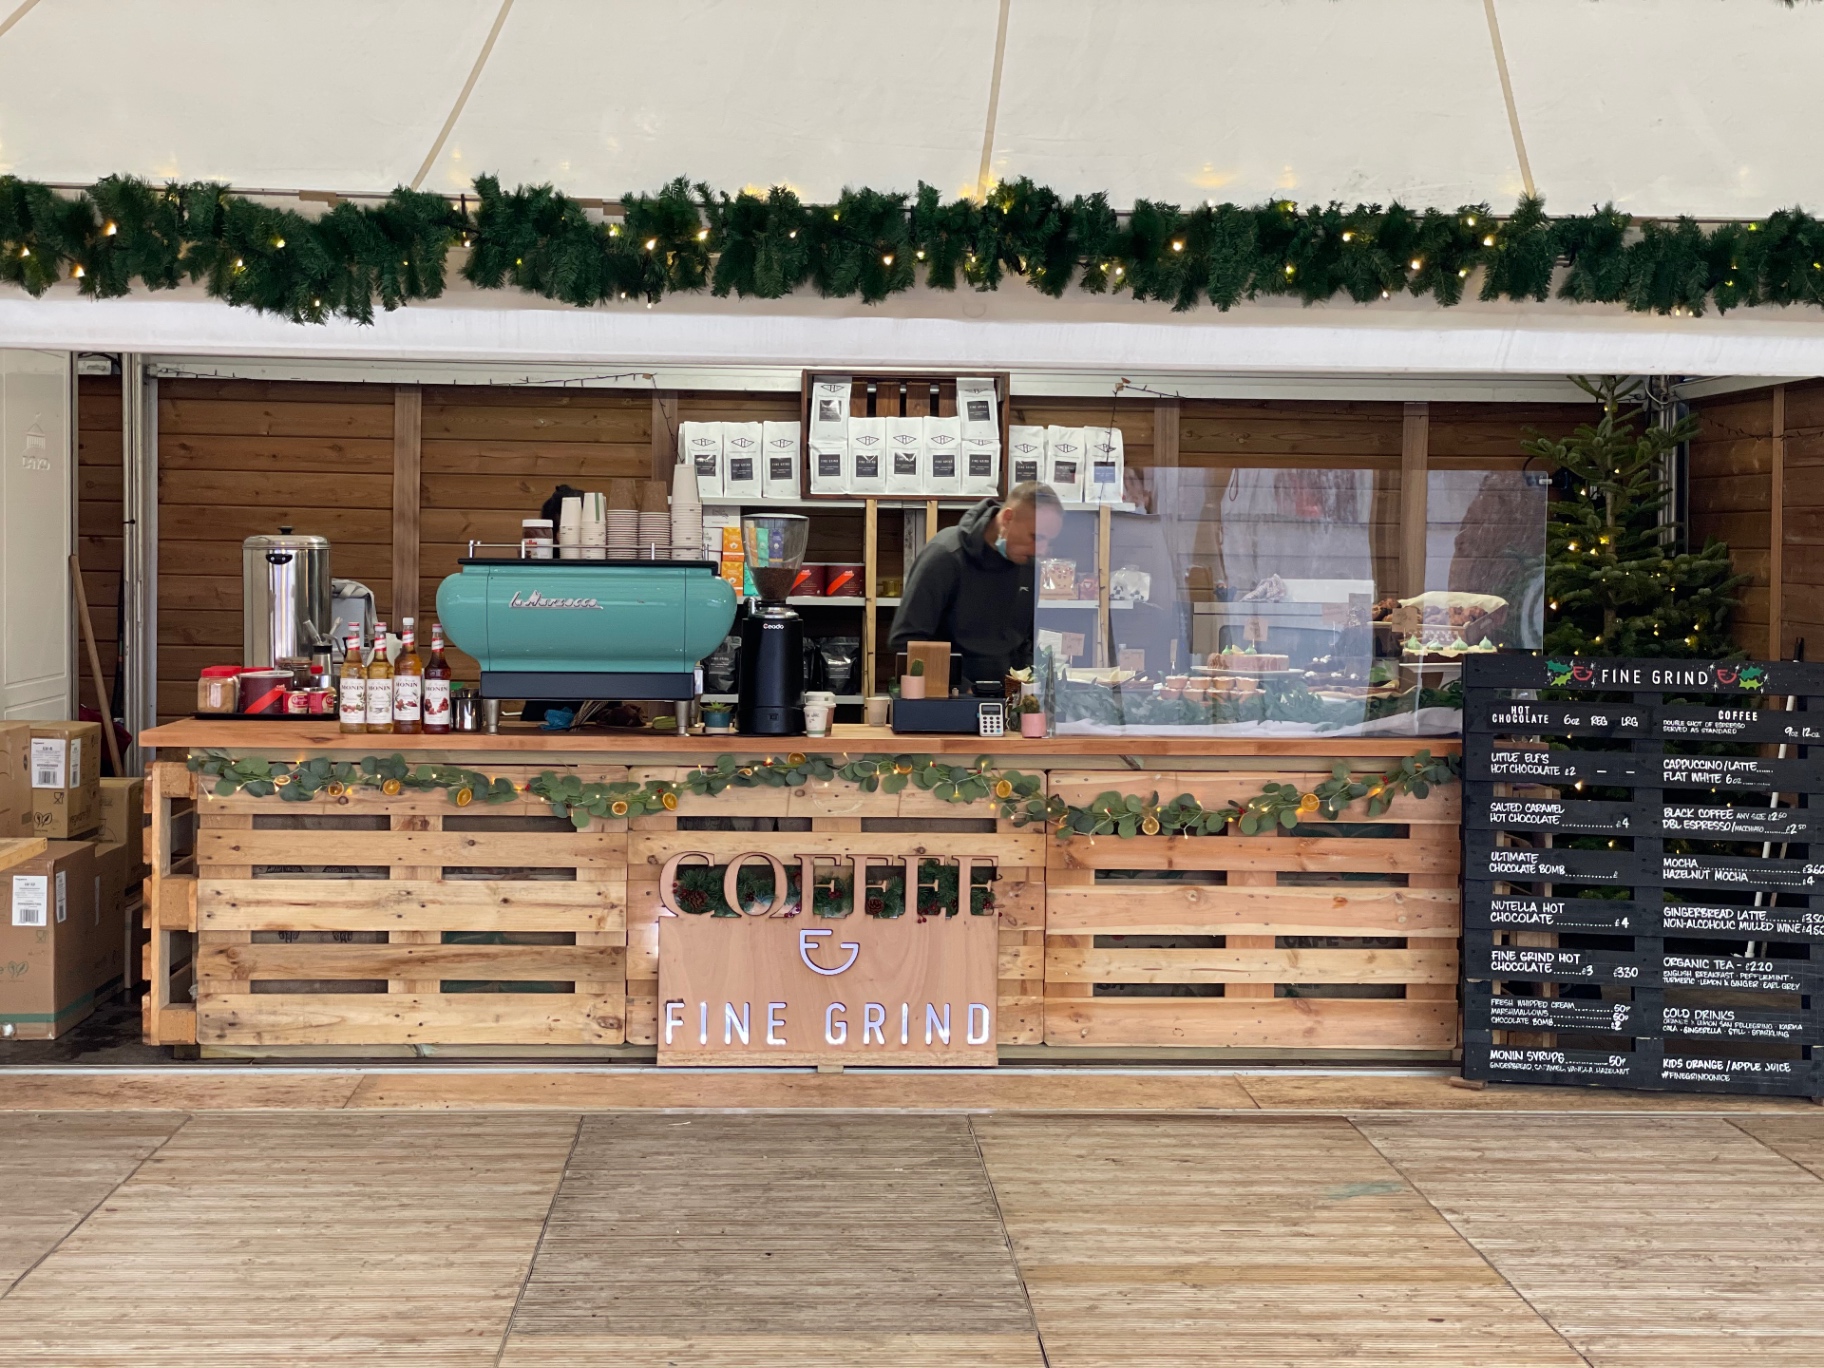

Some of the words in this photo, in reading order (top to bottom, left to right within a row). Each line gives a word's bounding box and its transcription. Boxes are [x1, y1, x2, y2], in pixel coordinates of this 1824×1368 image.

[1601, 669, 1641, 685] FINE
[1651, 670, 1708, 686] GRIND
[1511, 705, 1530, 714] HOT
[1718, 710, 1758, 721] COFFEE
[1492, 713, 1549, 724] CHOCOLATE
[1563, 714, 1580, 725] 6oz
[1590, 715, 1608, 726] REG
[1620, 716, 1639, 727] LRG
[1714, 721, 1746, 729] ESPRESSO
[1701, 727, 1738, 735] STANDARD
[1491, 752, 1520, 763] LITTLE
[1524, 753, 1550, 764] ELF'S
[1490, 763, 1509, 774] HOT
[1509, 764, 1561, 776] CHOCOLATE
[1564, 766, 1577, 776] £2
[1663, 771, 1688, 783] FLAT
[1691, 772, 1723, 784] WHITE
[1490, 802, 1523, 813] SALTED
[1524, 803, 1566, 814] CARAMEL
[1663, 807, 1695, 819] BLACK
[1697, 809, 1734, 820] COFFEE
[1736, 812, 1750, 820] ANY
[1750, 812, 1767, 821] SIZE
[1489, 813, 1507, 823] HOT
[1508, 814, 1561, 825] CHOCOLATE
[1662, 819, 1683, 830] DBL
[1490, 851, 1539, 864] ULTIMATE
[1663, 858, 1699, 868] MOCHA
[1489, 863, 1537, 874] CHOCOLATE
[1538, 864, 1566, 875] BOMB
[1663, 868, 1711, 880] HAZELNUT
[1714, 870, 1749, 882] MOCHA
[659, 851, 999, 918] COFFEE
[1490, 900, 1538, 913] NUTELLA
[1542, 902, 1566, 914] HOT
[1663, 906, 1734, 919] GINGERBREAD
[1737, 910, 1768, 921] LATTE
[1490, 911, 1554, 925] CHOCOLATE
[1663, 918, 1736, 930] NON-ALCOHOLIC
[1738, 920, 1774, 932] MULLED
[1776, 923, 1802, 934] WINE
[1491, 950, 1517, 962] FINE
[1519, 951, 1555, 963] GRIND
[1558, 953, 1581, 965] HOT
[1663, 957, 1710, 969] ORGANIC
[1713, 959, 1734, 970] TEA
[1490, 961, 1553, 973] CHOCOLATE
[1695, 970, 1734, 979] BREAKFAST
[1662, 977, 1696, 985] TURMERIC
[1699, 979, 1723, 987] LEMON
[1730, 979, 1759, 988] GINGER
[1762, 981, 1780, 990] EARL
[1781, 982, 1801, 991] GREY
[1490, 998, 1514, 1006] FRESH
[1517, 999, 1549, 1009] WHIPPED
[1550, 1001, 1576, 1010] CREAM
[1490, 1007, 1549, 1018] MARSHMALLOWS
[1663, 1007, 1690, 1019] COLD
[1694, 1009, 1735, 1021] DRINKS
[665, 1001, 788, 1045] FINE
[825, 1001, 990, 1045] GRIND
[1490, 1016, 1530, 1025] CHOCOLATE
[1532, 1017, 1554, 1027] BOMB
[1696, 1019, 1718, 1027] LEMON
[1719, 1020, 1733, 1028] SAN
[1728, 1027, 1746, 1036] STILL
[1751, 1029, 1790, 1039] SPARKLING
[1489, 1050, 1524, 1061] MONIN
[1526, 1051, 1566, 1064] SYRUPS
[1662, 1058, 1684, 1069] KIDS
[1685, 1059, 1724, 1071] ORANGE
[1764, 1062, 1792, 1073] JUICE
